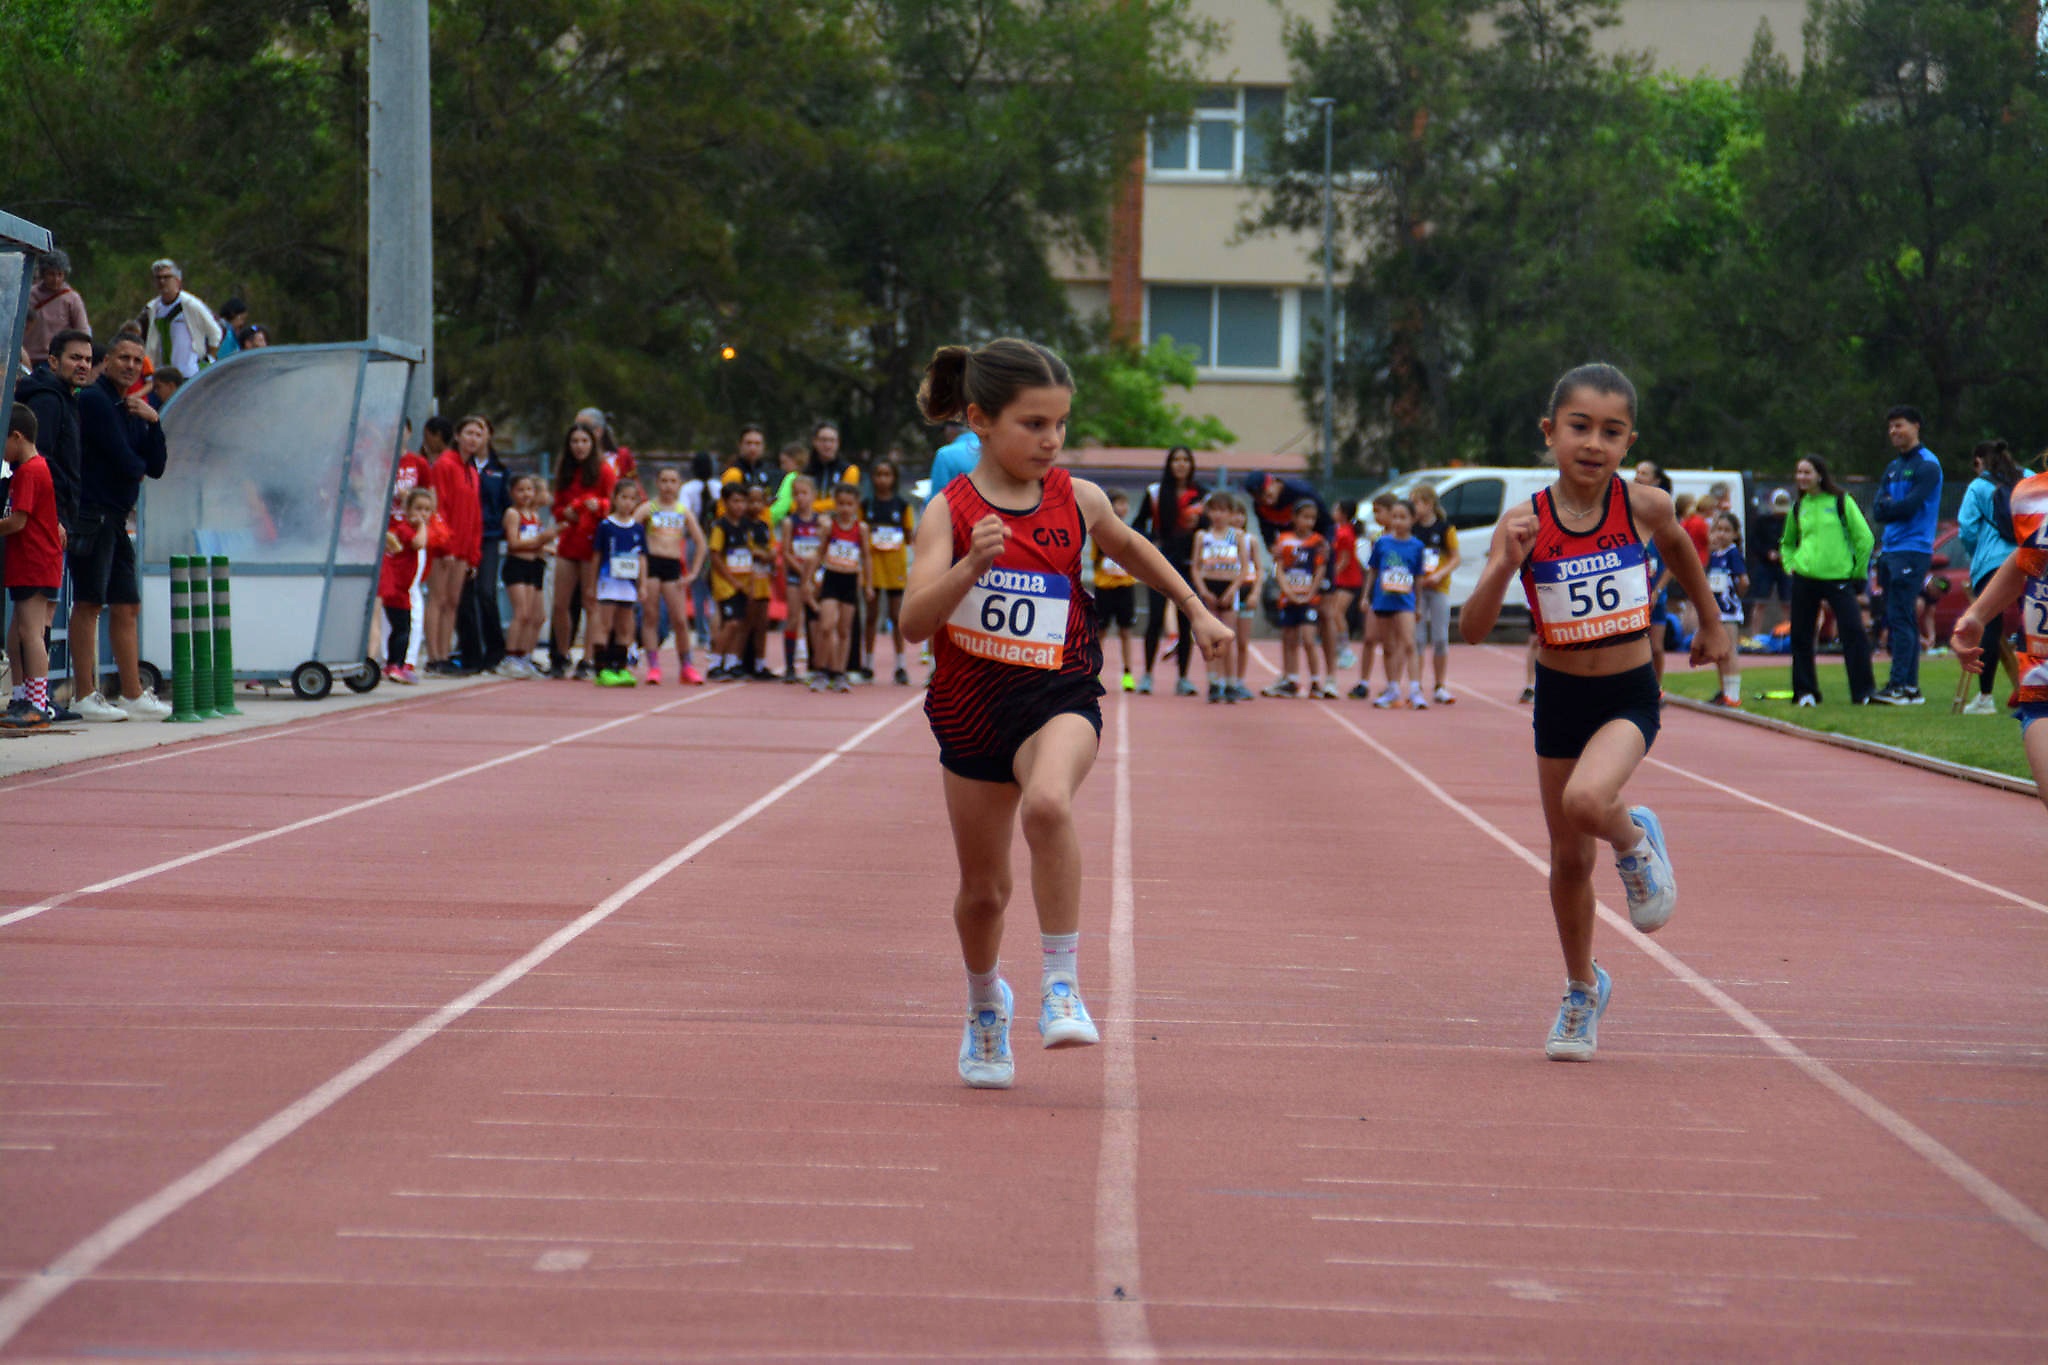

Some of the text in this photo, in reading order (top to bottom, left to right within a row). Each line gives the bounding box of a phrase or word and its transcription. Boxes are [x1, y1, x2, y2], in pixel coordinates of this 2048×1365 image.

[978, 569, 1047, 594] Joma
[1556, 552, 1622, 581] Joma
[1568, 575, 1620, 618] 56
[980, 594, 1036, 637] 60
[1551, 609, 1647, 643] mutuacat
[952, 631, 1056, 667] mutuacat
